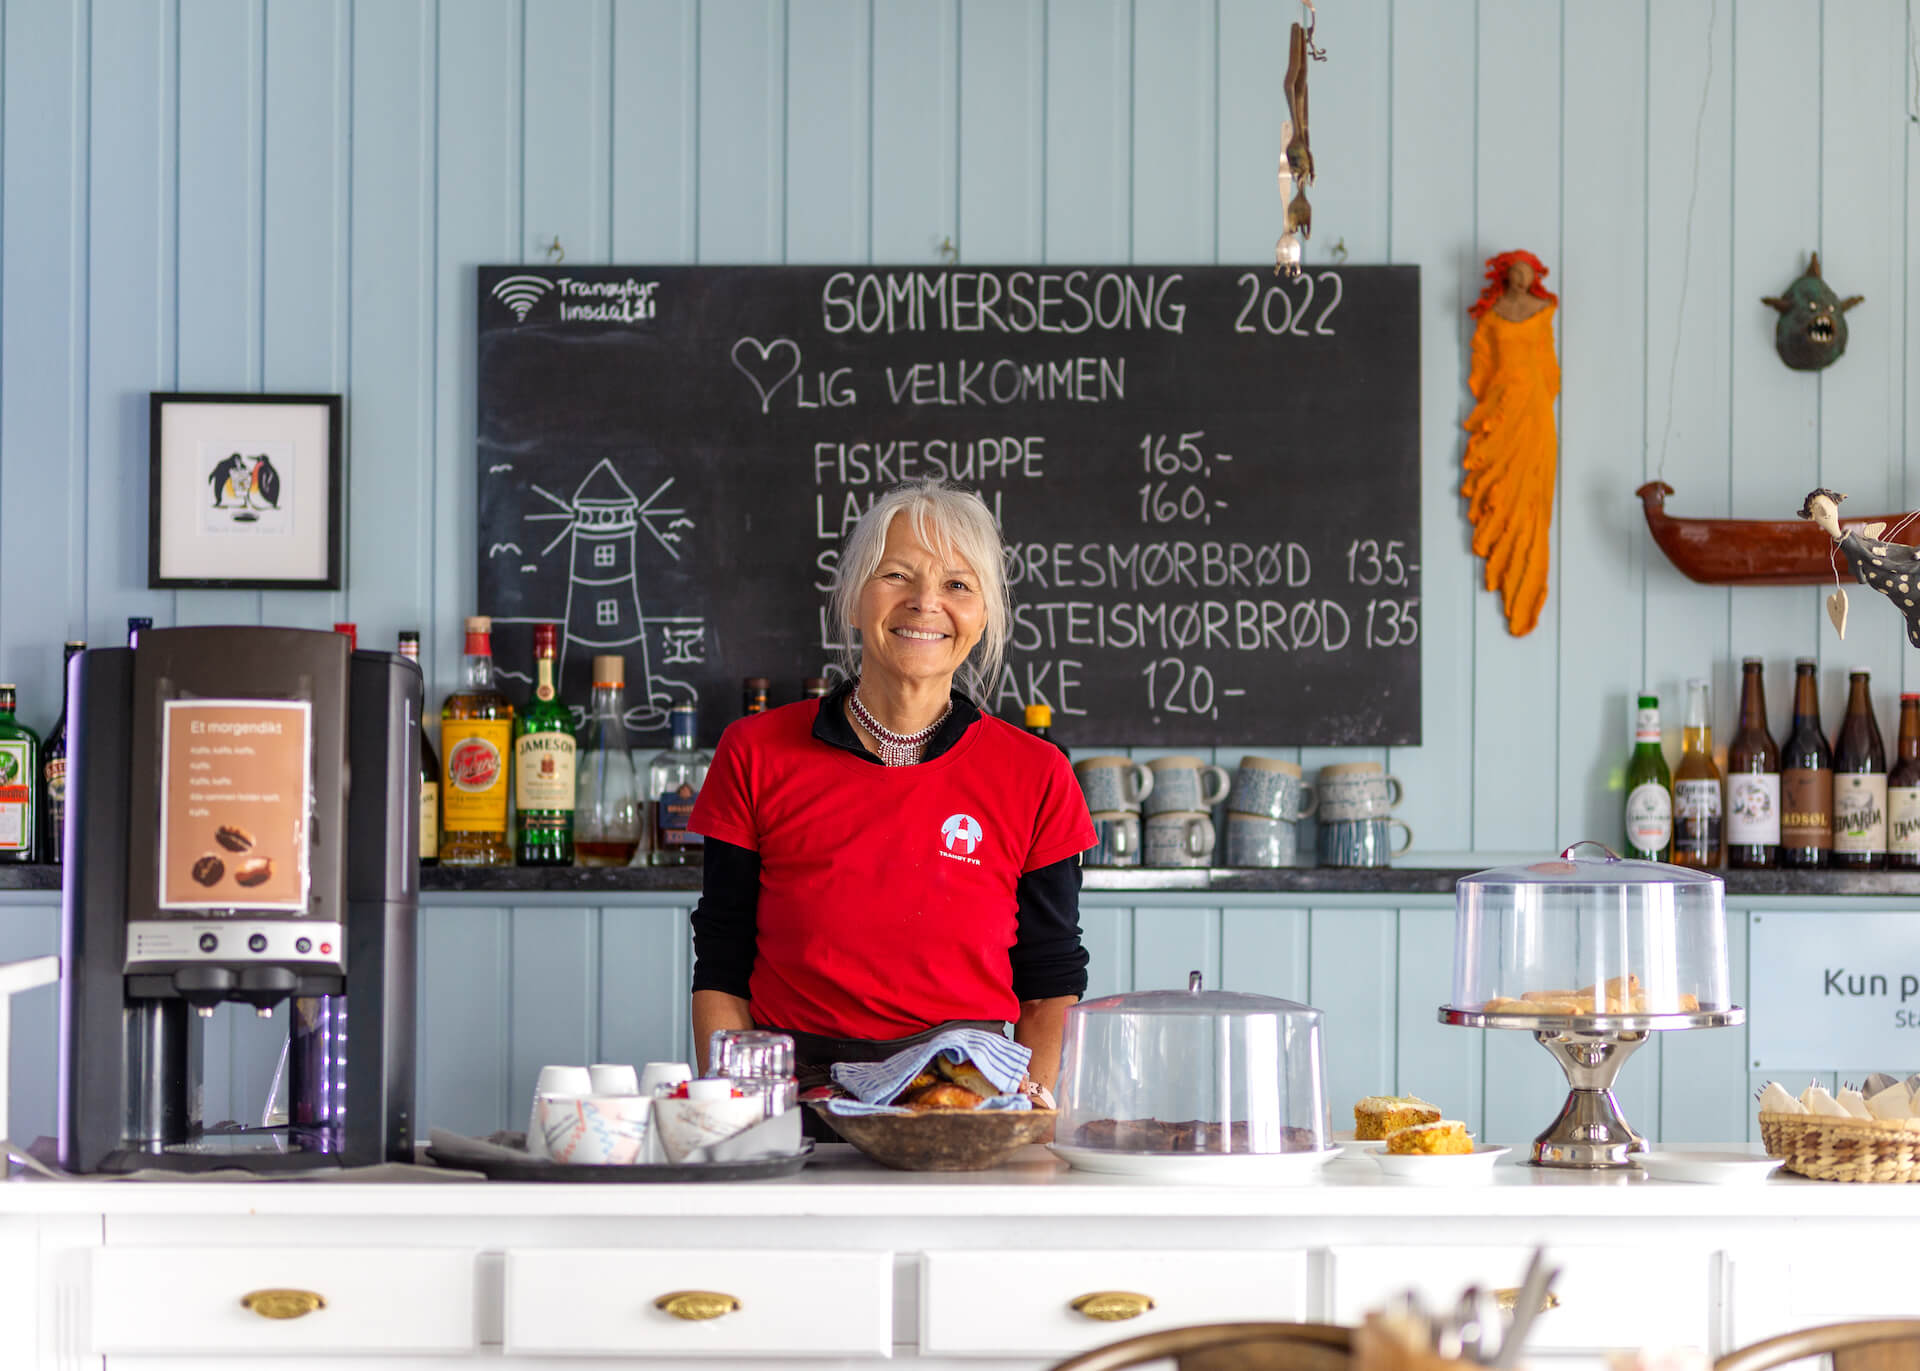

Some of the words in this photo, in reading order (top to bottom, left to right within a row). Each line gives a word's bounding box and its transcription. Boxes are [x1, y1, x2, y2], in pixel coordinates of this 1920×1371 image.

[822, 271, 1187, 334] SOMMERSESONG
[1234, 271, 1343, 336] 2022
[797, 367, 857, 408] LIG
[885, 357, 1126, 406] VELKOMMEN
[814, 436, 1046, 485] FISKESUPPE
[1139, 430, 1233, 478] 165,-
[1138, 480, 1229, 525] 160,-
[1346, 538, 1420, 588] 135,-
[1366, 597, 1419, 649] 135
[1142, 657, 1246, 720] 120,-
[190, 720, 205, 734] Et
[207, 720, 283, 737] morgendikt
[520, 738, 574, 755] JAMESON
[1824, 967, 1888, 997] Kun
[1894, 1008, 1920, 1029] St
